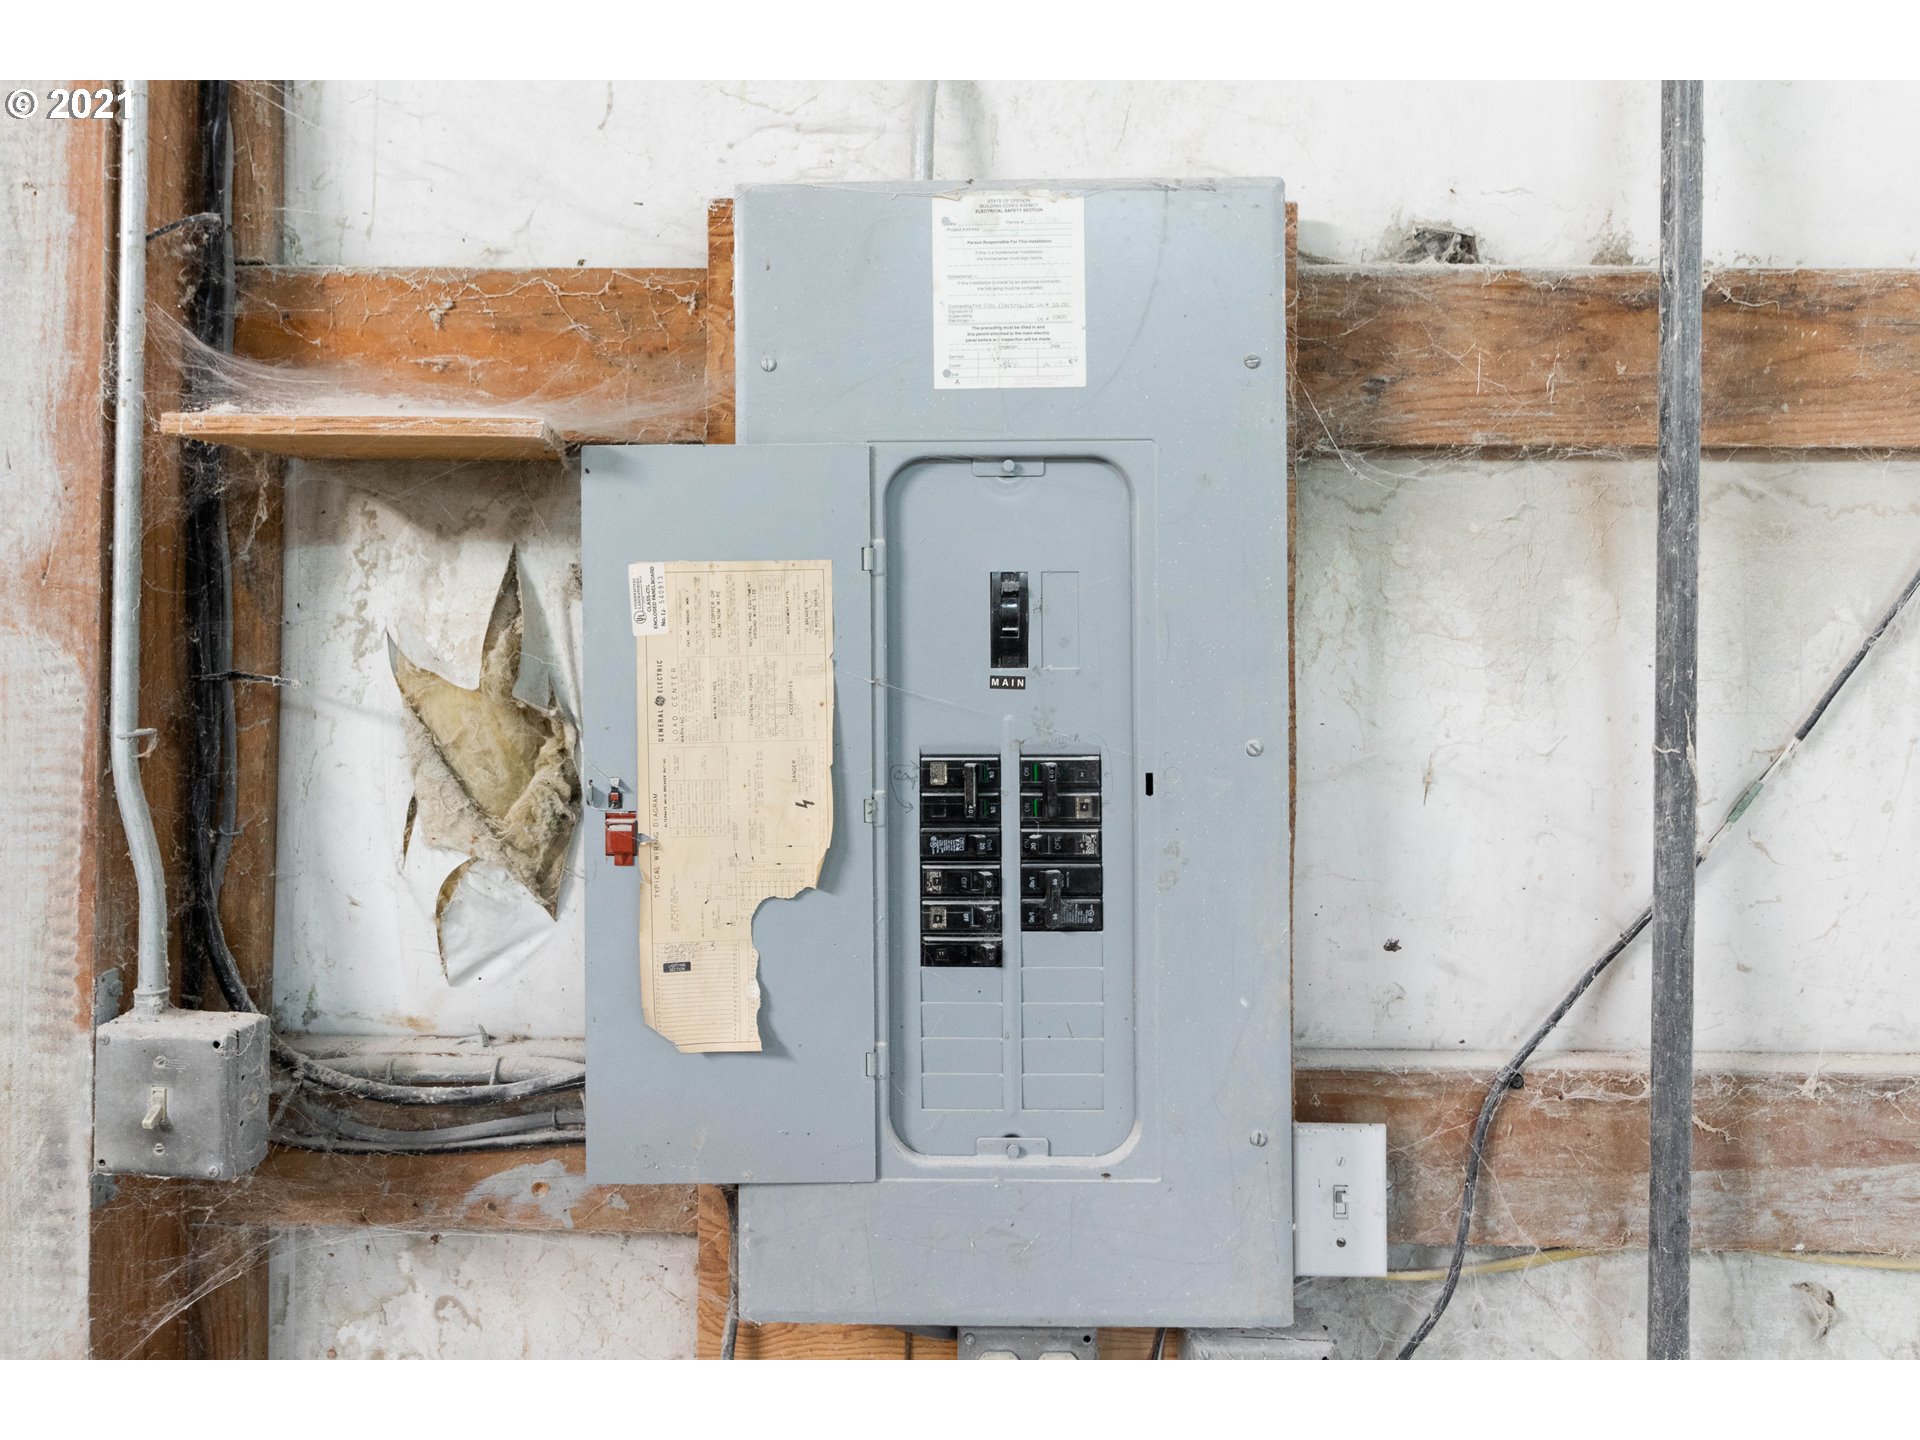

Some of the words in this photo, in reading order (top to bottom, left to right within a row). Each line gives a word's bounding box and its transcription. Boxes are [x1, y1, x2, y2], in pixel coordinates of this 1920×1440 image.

[657, 576, 665, 604] 540913
[710, 590, 716, 598] OR
[991, 678, 1024, 687] MAIN
[657, 710, 665, 742] GENERAL
[1024, 766, 1030, 777] ON
[986, 880, 992, 888] 20
